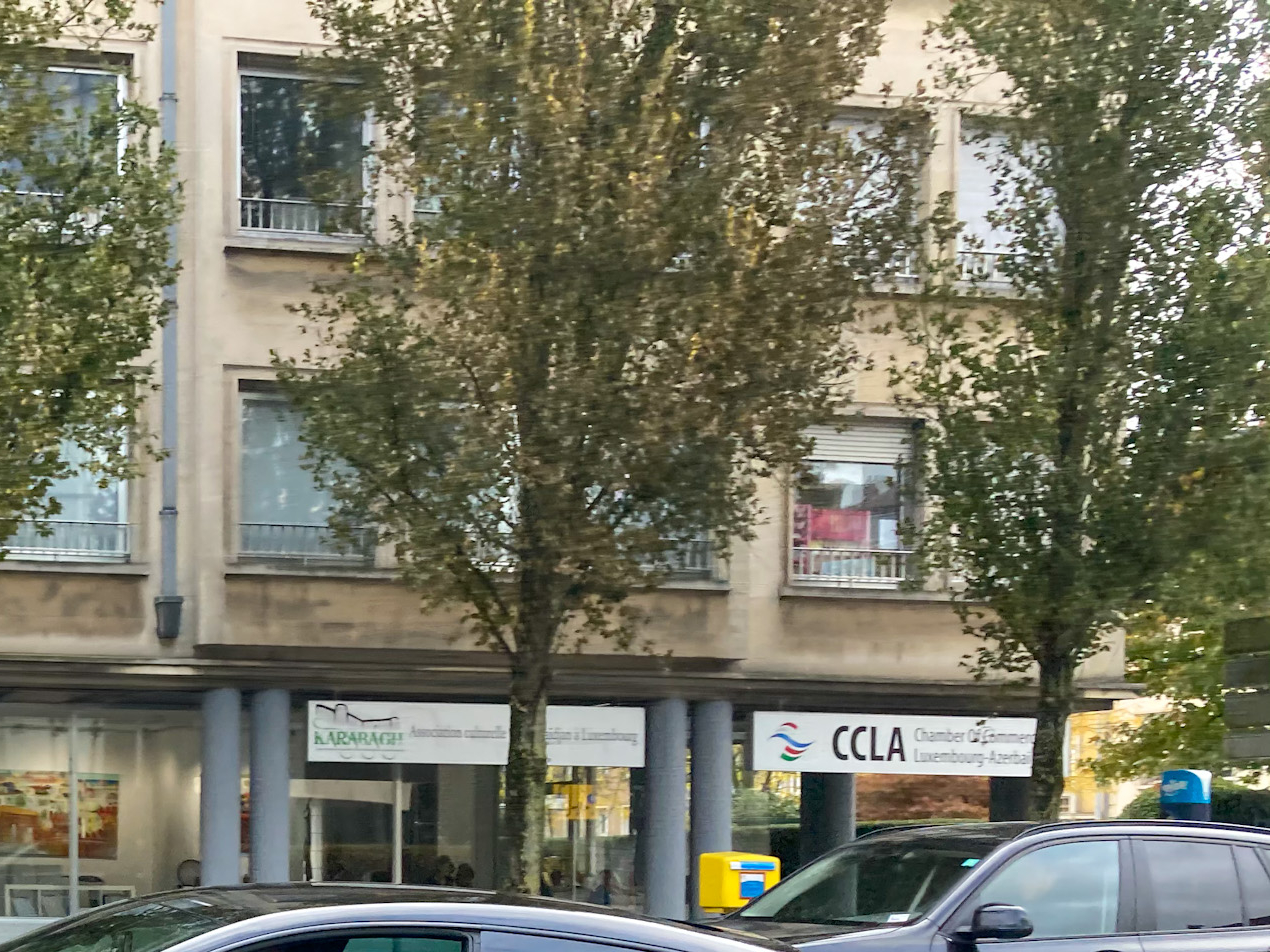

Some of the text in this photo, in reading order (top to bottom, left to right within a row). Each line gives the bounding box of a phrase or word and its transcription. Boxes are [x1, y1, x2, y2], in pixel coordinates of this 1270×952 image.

[314, 727, 404, 746] KARABAGH
[832, 726, 906, 761] CCLA
[914, 727, 966, 743] Chamber
